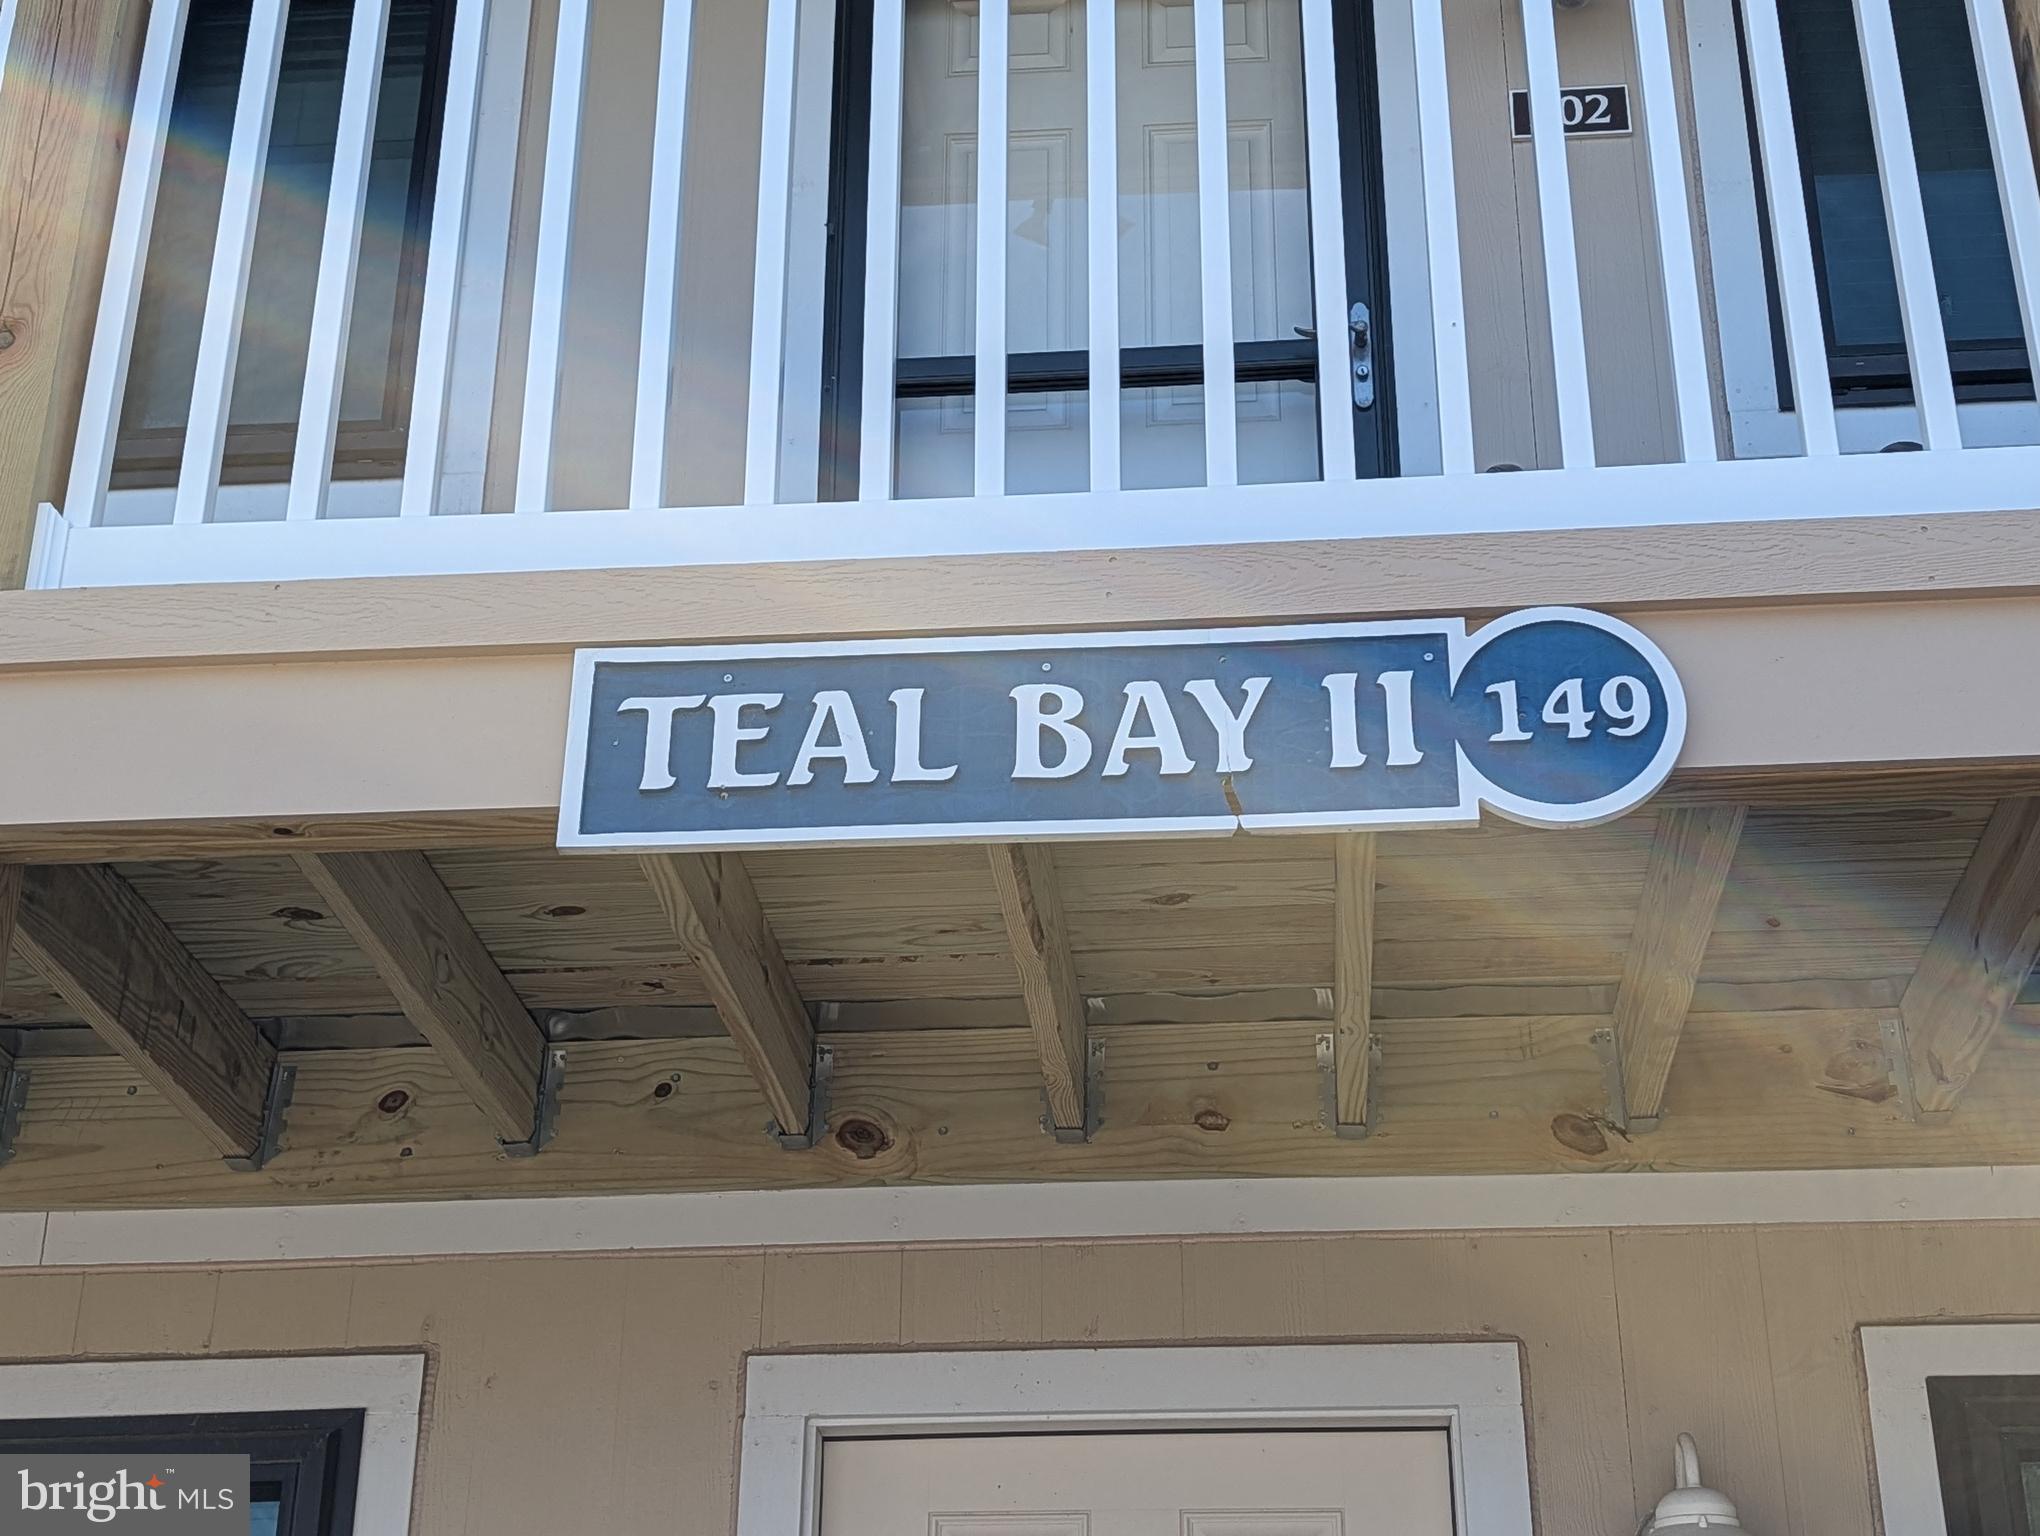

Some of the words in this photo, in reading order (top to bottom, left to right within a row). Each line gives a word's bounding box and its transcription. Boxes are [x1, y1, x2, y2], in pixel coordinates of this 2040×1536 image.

[1560, 94, 1612, 126] 02
[616, 689, 959, 791] TEAL
[1008, 676, 1272, 780] BAY
[1321, 670, 1425, 769] II
[1485, 675, 1652, 743] 149
